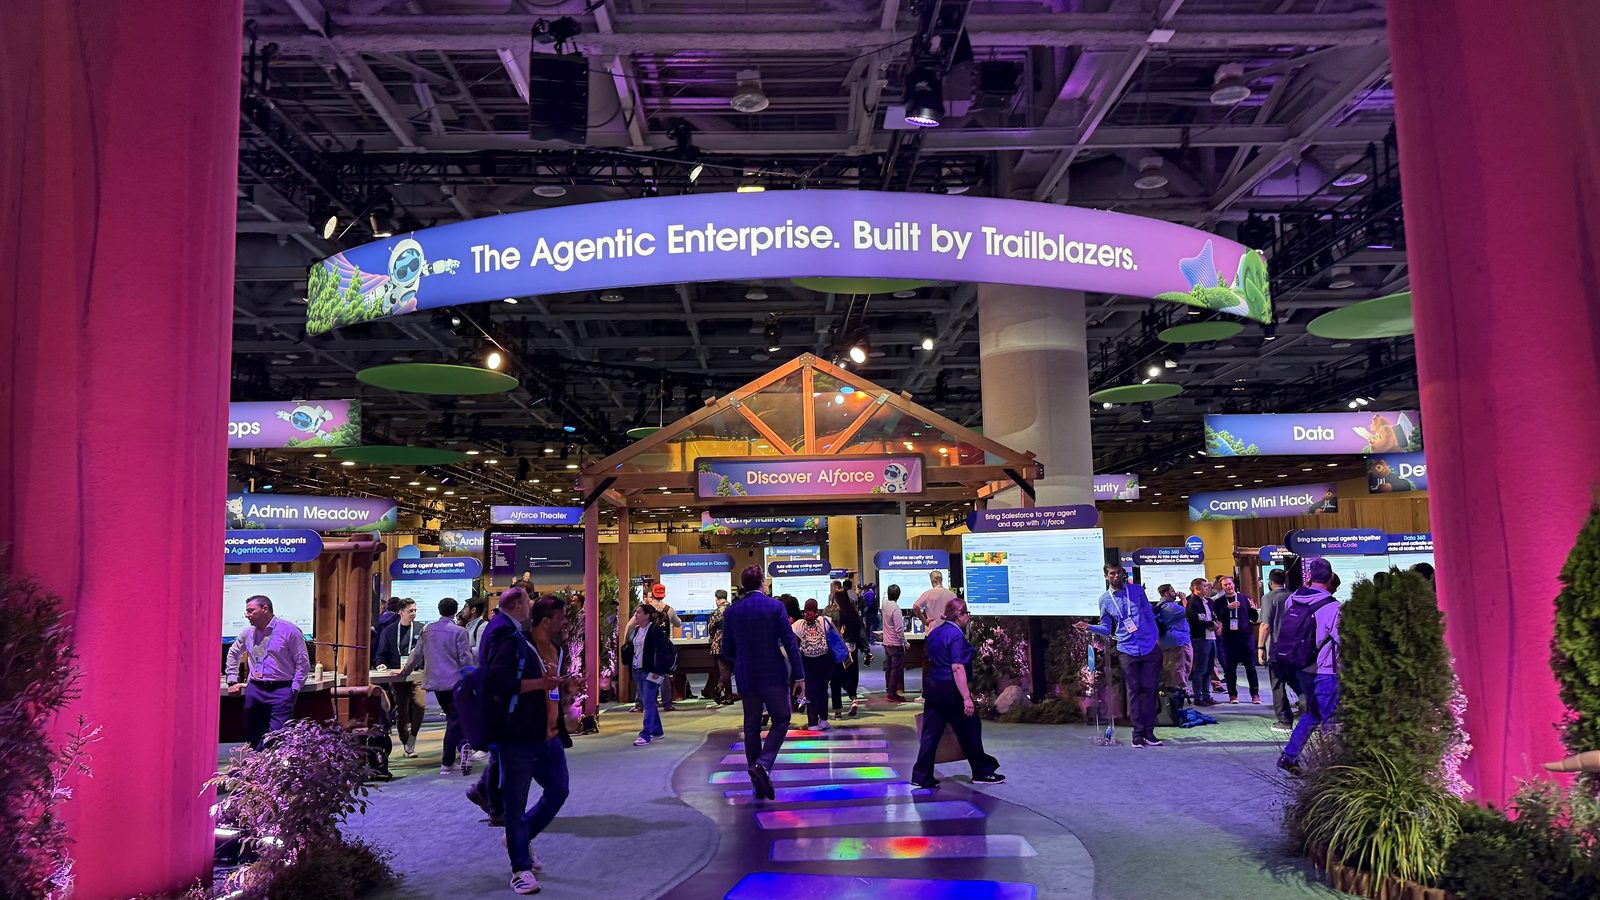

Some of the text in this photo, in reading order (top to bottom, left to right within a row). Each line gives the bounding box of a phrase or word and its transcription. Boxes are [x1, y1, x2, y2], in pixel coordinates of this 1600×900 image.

[470, 218, 1139, 274] The Agentic Enterprise. Built by Trailblazers.
[1293, 425, 1335, 441] Data
[1398, 463, 1427, 478] De
[746, 471, 812, 485] Discover
[1209, 493, 1315, 512] Camp Mini Hack
[246, 504, 370, 521] Admin Meadow
[540, 511, 567, 519] Theater
[985, 513, 1001, 521] Bring
[1001, 511, 1035, 520] Salesforce
[1043, 511, 1056, 519] any
[1056, 509, 1077, 518] agent
[997, 520, 1011, 528] and
[1011, 520, 1025, 528] app
[1026, 519, 1040, 527] with
[224, 536, 307, 546] voice-enabled agents
[1339, 535, 1358, 543] agents
[1358, 534, 1381, 542] together
[231, 546, 273, 556] Agentforce
